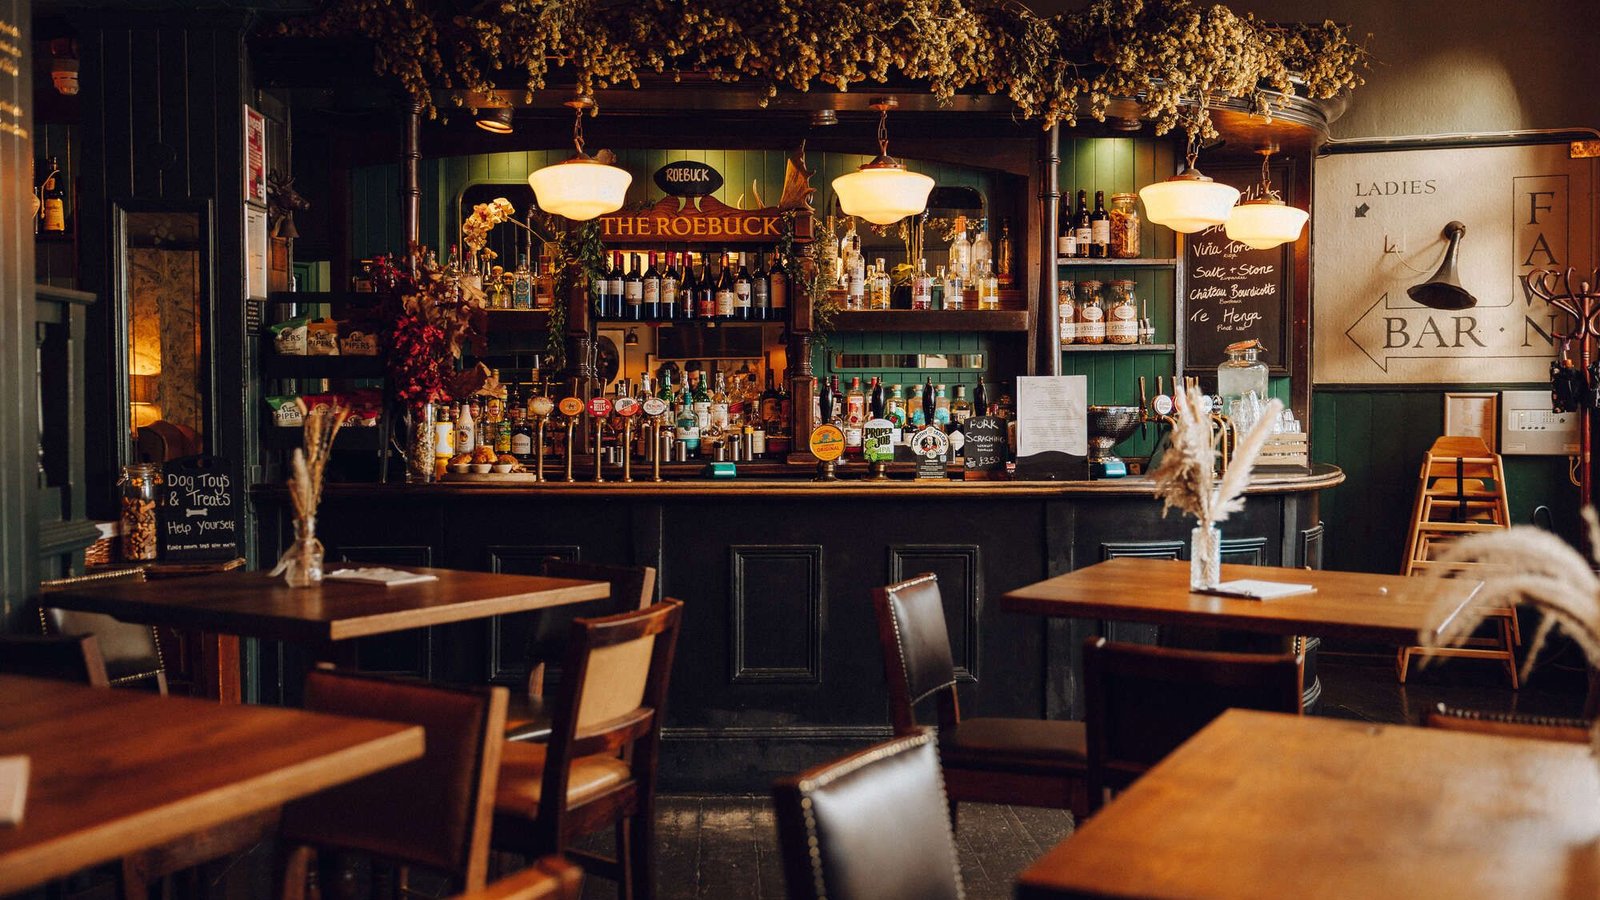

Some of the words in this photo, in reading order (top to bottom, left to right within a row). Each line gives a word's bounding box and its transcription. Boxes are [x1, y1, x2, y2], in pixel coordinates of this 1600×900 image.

[666, 168, 710, 182] ROEBUCK
[1355, 179, 1437, 197] LADIES
[600, 216, 651, 236] THE
[656, 216, 781, 236] ROEBUCK
[1193, 242, 1222, 257] Viña
[1193, 266, 1226, 279] Salt
[1237, 263, 1274, 276] Stone
[1190, 285, 1227, 300] Château
[1190, 308, 1210, 322] Te
[1223, 307, 1263, 328] Henga
[1383, 316, 1487, 348] BAR
[308, 339, 332, 347] PIPERS
[344, 341, 371, 350] PIPERS
[276, 411, 301, 419] PIPER
[865, 427, 893, 439] PROPER
[875, 435, 891, 448] JOB
[167, 473, 194, 492] Dog
[169, 491, 179, 506] &
[185, 489, 231, 506] Treats
[167, 521, 192, 535] Help
